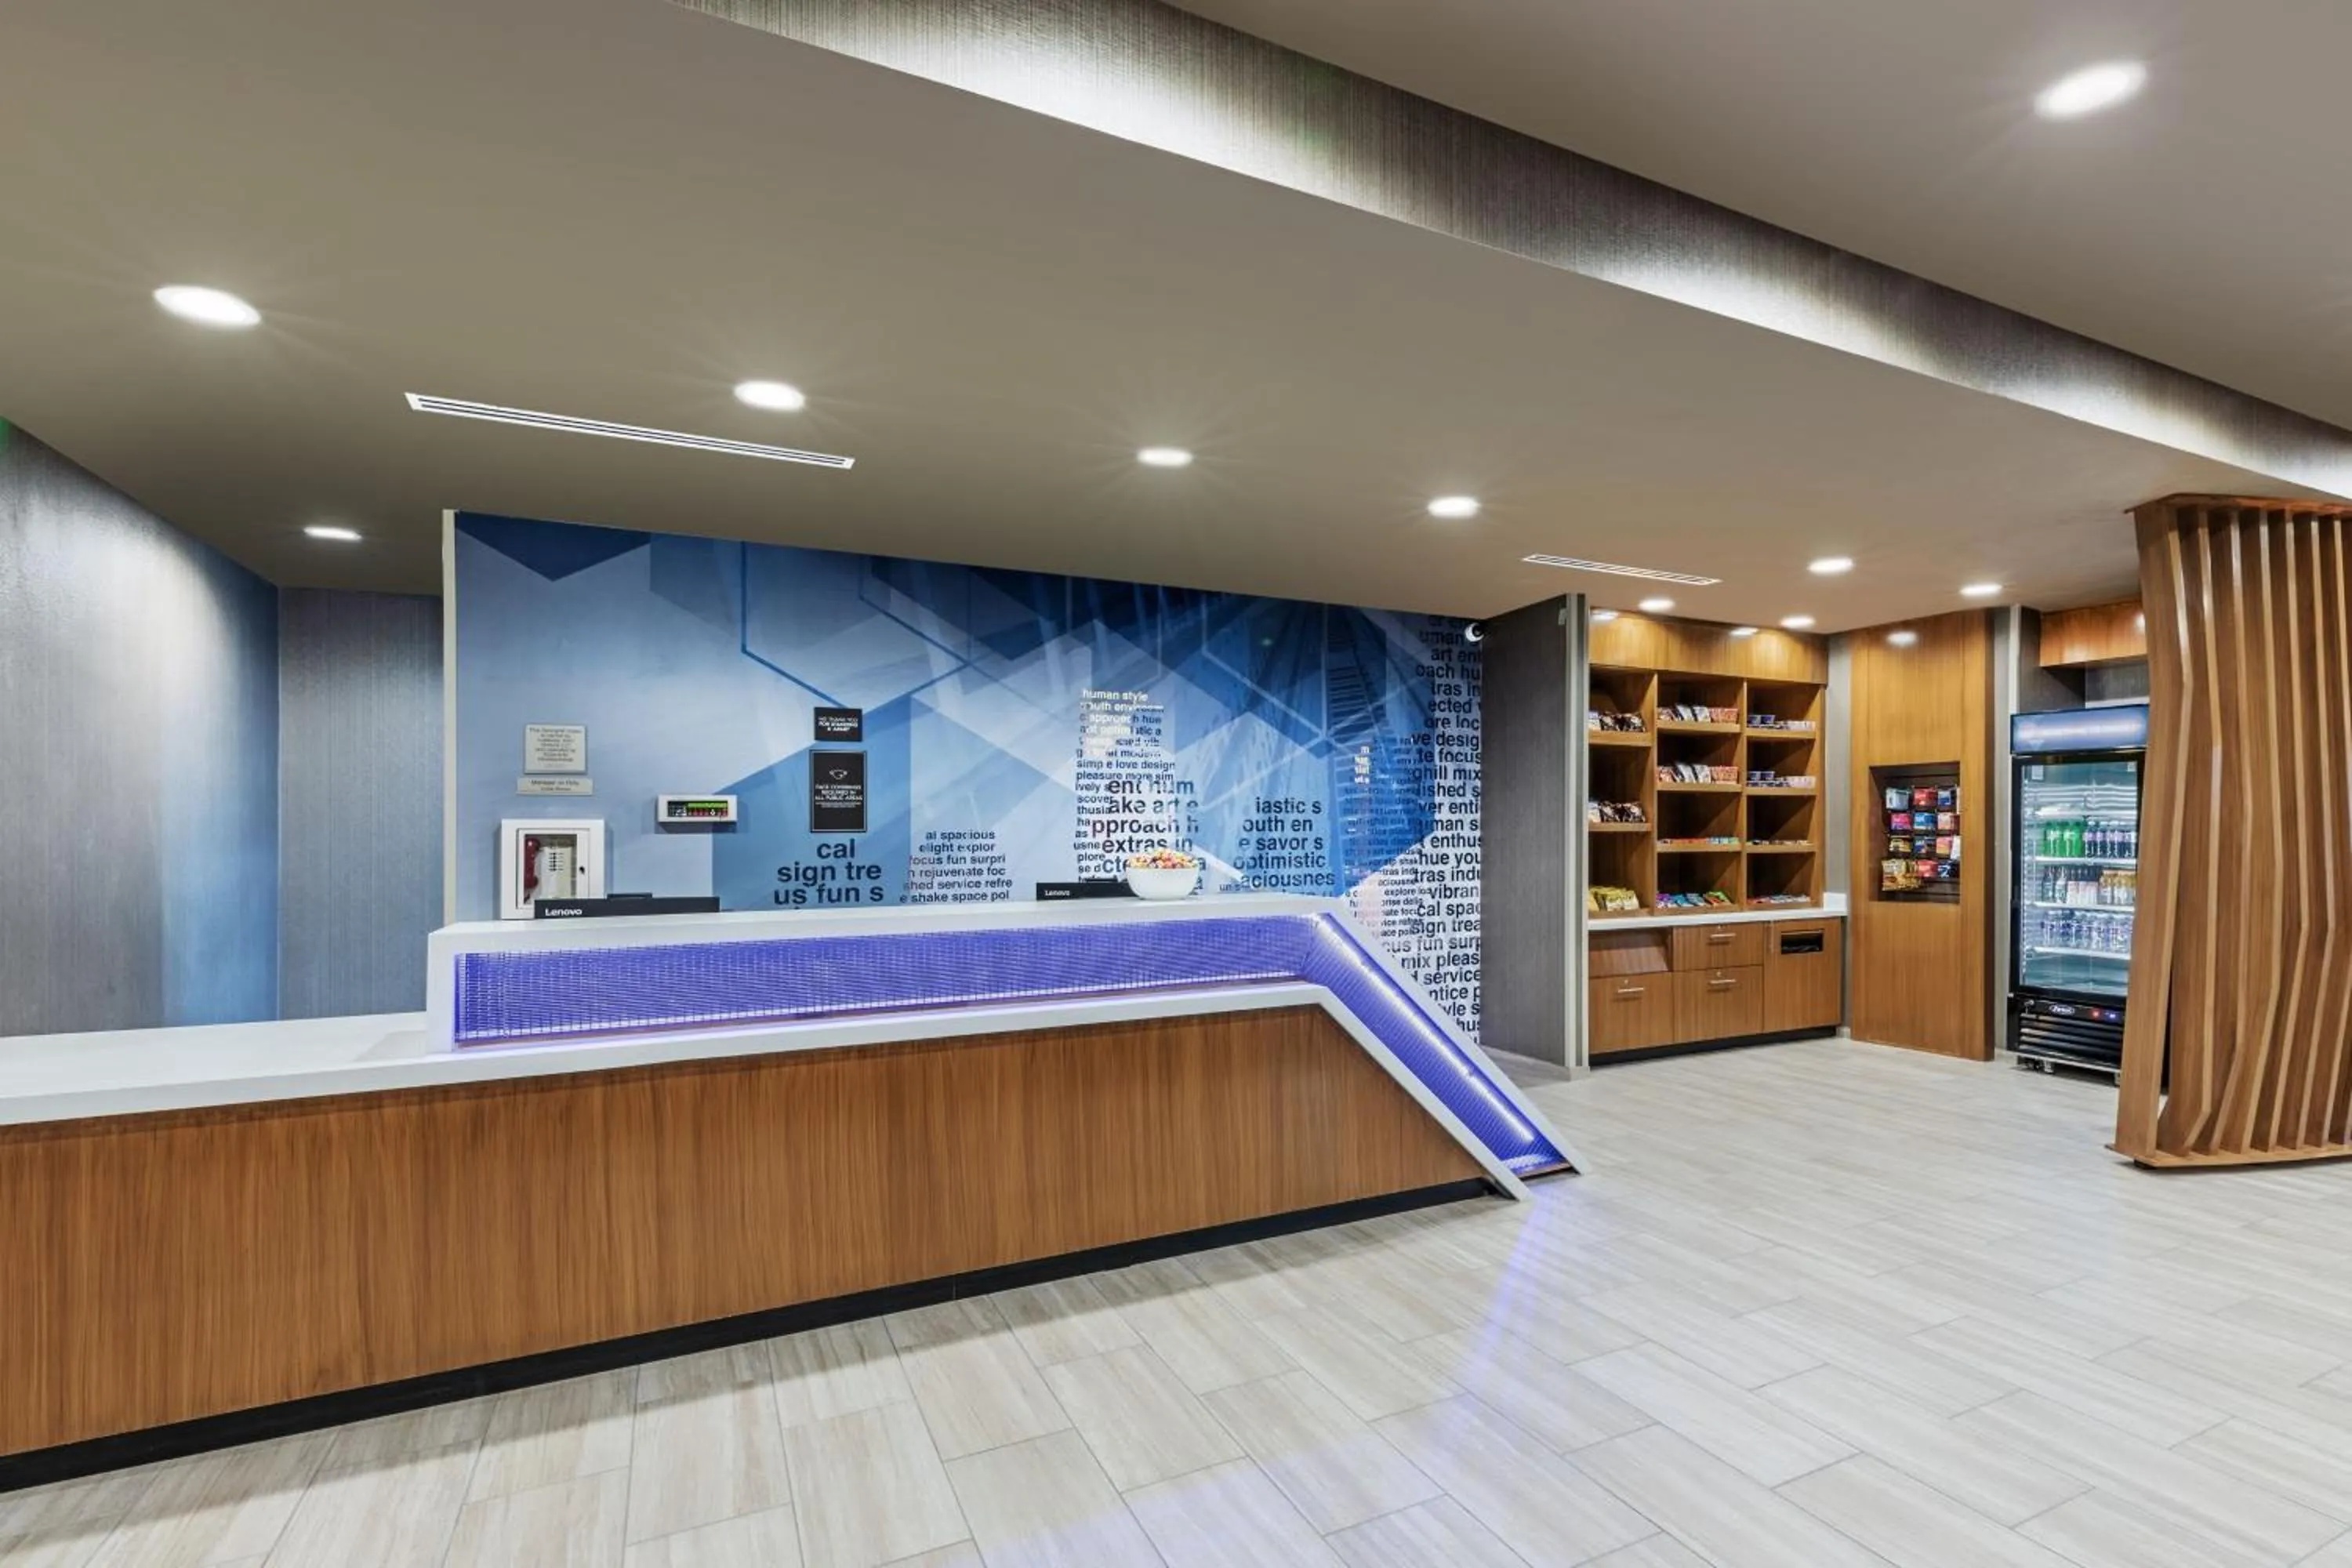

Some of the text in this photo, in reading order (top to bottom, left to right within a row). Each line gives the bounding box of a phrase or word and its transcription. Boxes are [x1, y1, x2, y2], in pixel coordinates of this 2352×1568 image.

[1083, 688, 1119, 699] human
[1428, 696, 1472, 713] ected
[1076, 759, 1112, 771] simpe
[1116, 759, 1138, 769] love
[1076, 771, 1123, 783] pleasure
[1256, 797, 1322, 815] iastic s
[1291, 818, 1313, 833] en
[941, 829, 996, 842] spacious
[816, 838, 855, 859] cal
[1256, 837, 1308, 851] savor
[1313, 837, 1323, 851] s
[947, 854, 967, 864] fun
[970, 853, 1006, 866] surpri
[777, 862, 882, 887] sign tre
[920, 867, 984, 879] rejuvenate
[987, 866, 1006, 876] foc
[938, 878, 982, 890] service
[985, 877, 1013, 888] refre
[774, 883, 884, 906] us fun s
[911, 891, 949, 902] shake
[952, 891, 989, 903] space
[991, 890, 1009, 902] pol
[545, 908, 583, 916] Lenovo
[1436, 951, 1480, 970] pleas
[1423, 967, 1480, 985] service
